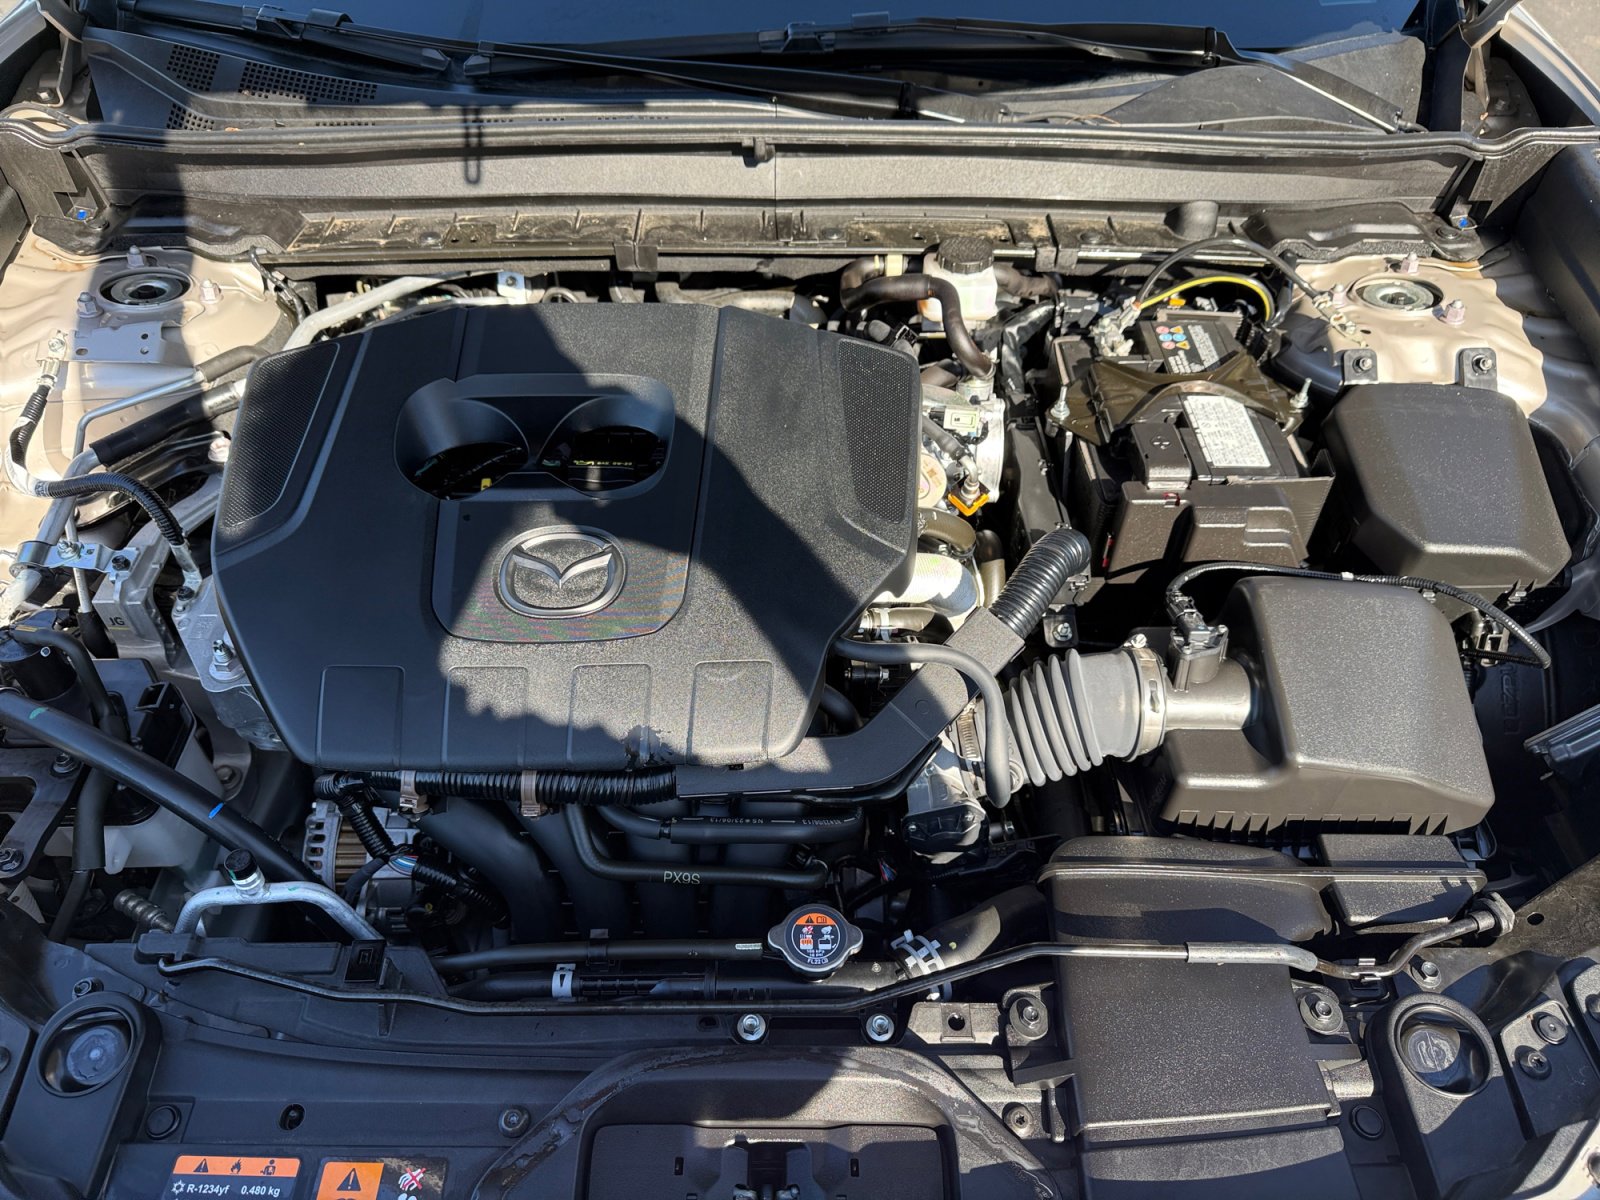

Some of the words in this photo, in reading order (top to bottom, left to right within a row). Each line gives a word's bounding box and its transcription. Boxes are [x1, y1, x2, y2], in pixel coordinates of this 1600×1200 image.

[663, 870, 701, 885] PX9S
[186, 1183, 230, 1196] R-1234yf
[240, 1185, 267, 1195] 0.480
[267, 1186, 280, 1197] kg
